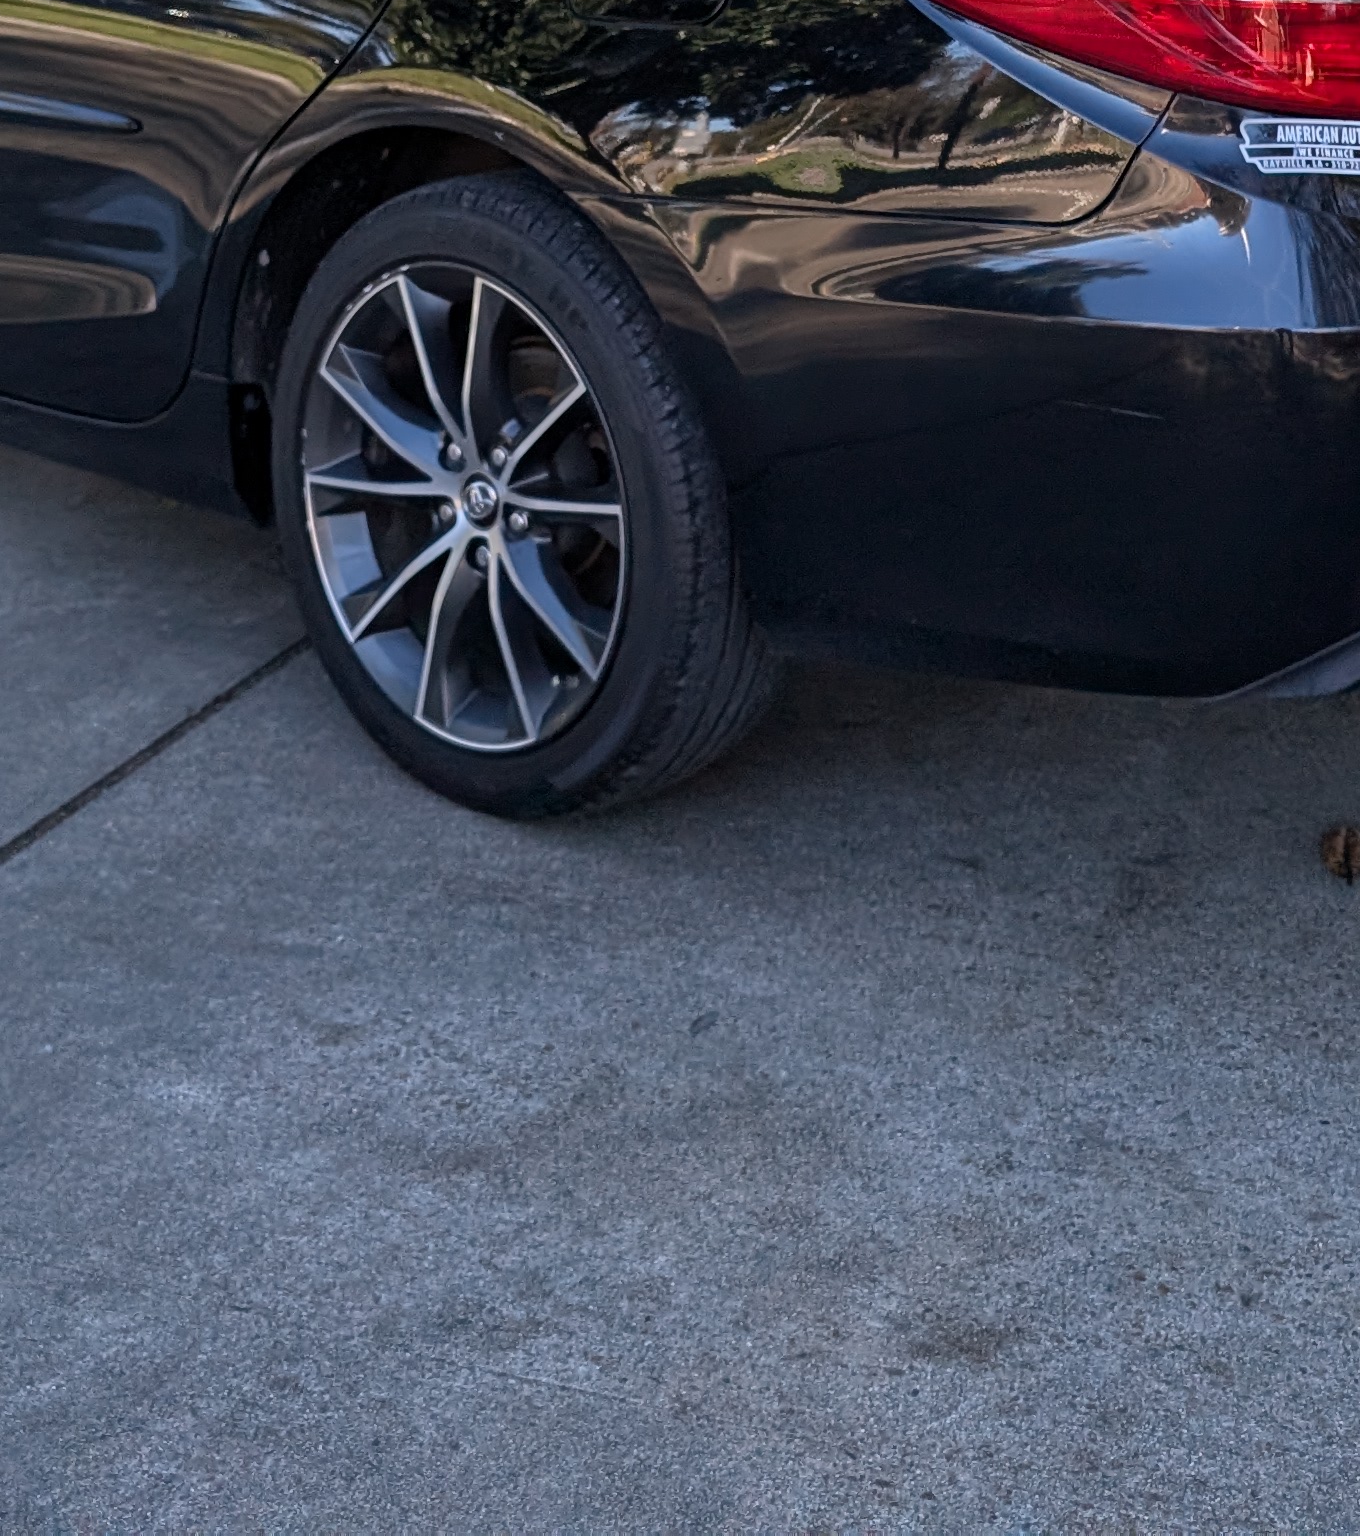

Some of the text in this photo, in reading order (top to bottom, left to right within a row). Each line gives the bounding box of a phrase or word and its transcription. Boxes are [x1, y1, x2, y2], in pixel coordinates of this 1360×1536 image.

[1276, 125, 1339, 144] AMERICAN
[1299, 148, 1354, 159] WE FINANCE
